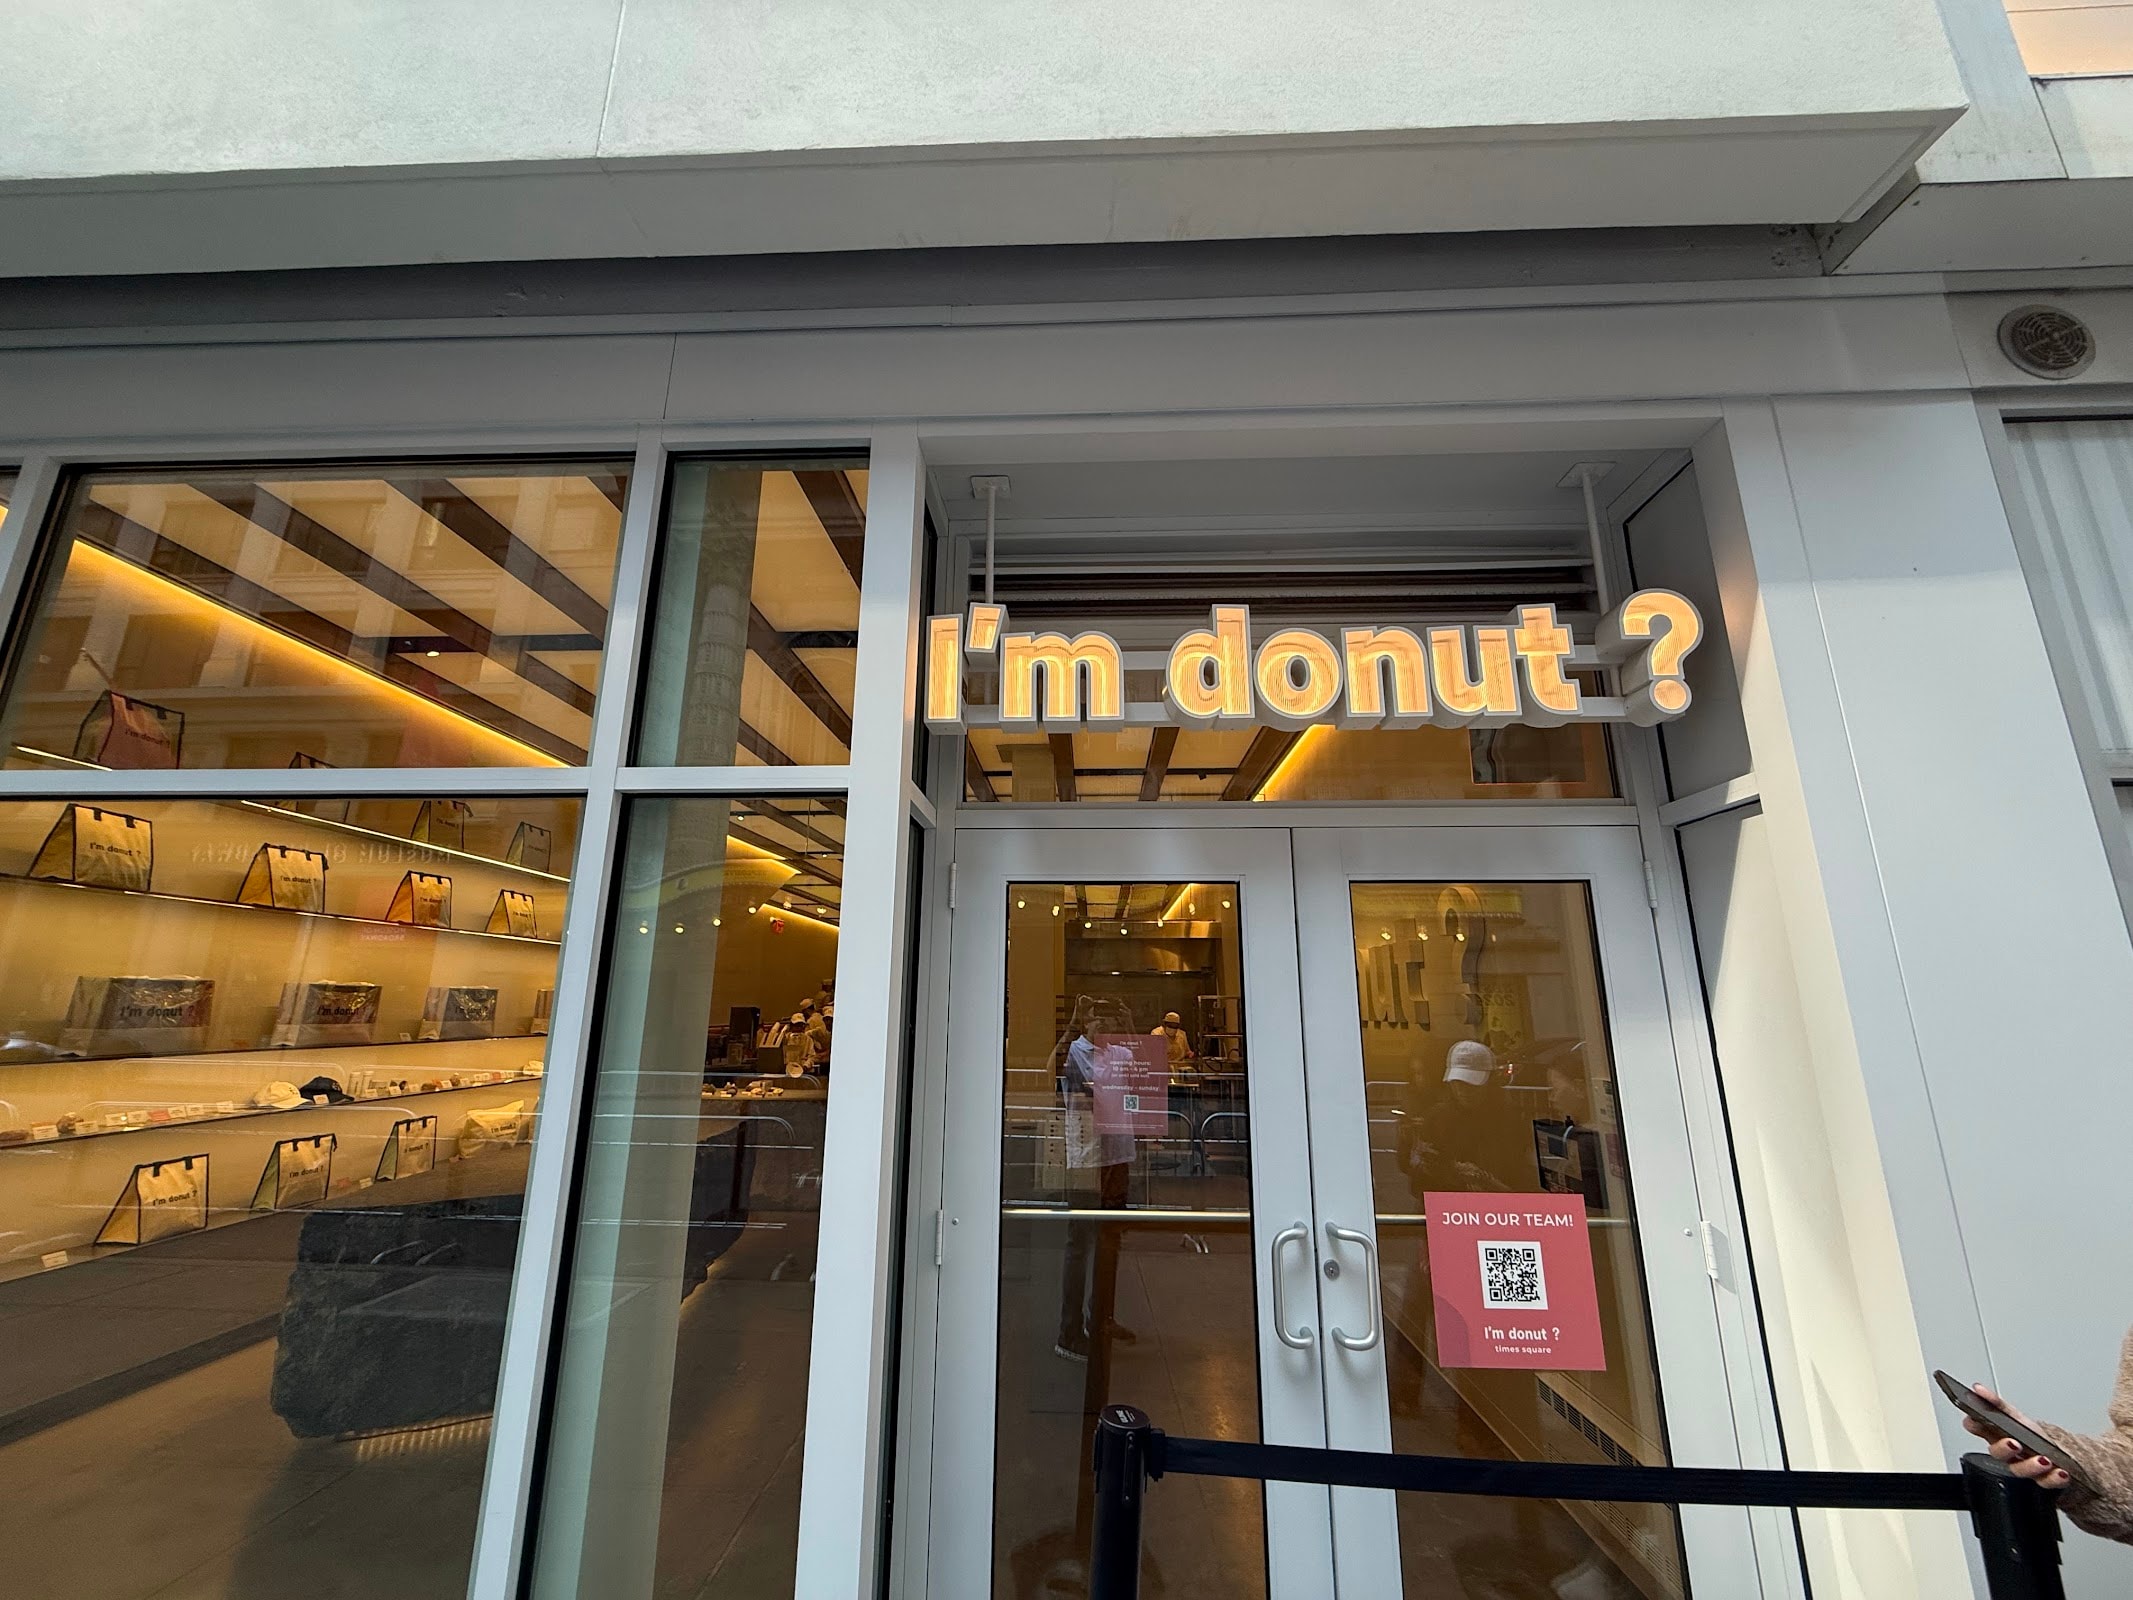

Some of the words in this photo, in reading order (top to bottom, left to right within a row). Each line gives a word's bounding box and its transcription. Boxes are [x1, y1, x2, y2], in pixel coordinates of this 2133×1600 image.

[926, 603, 1124, 722] I'm
[1166, 603, 1583, 721] donut
[1619, 588, 1704, 715] ?
[90, 842, 105, 851] I'm
[119, 1005, 142, 1017] I'm
[147, 1005, 183, 1018] donut
[153, 1198, 166, 1207] I'm
[168, 1193, 190, 1203] donut
[1442, 1212, 1480, 1226] JOIN
[1484, 1213, 1520, 1226] OUR
[1523, 1213, 1574, 1227] TEAM!
[1484, 1325, 1505, 1340] I'm
[1508, 1326, 1548, 1341] donut
[1552, 1326, 1560, 1341] ?
[1494, 1344, 1520, 1354] times
[1521, 1346, 1552, 1355] square
